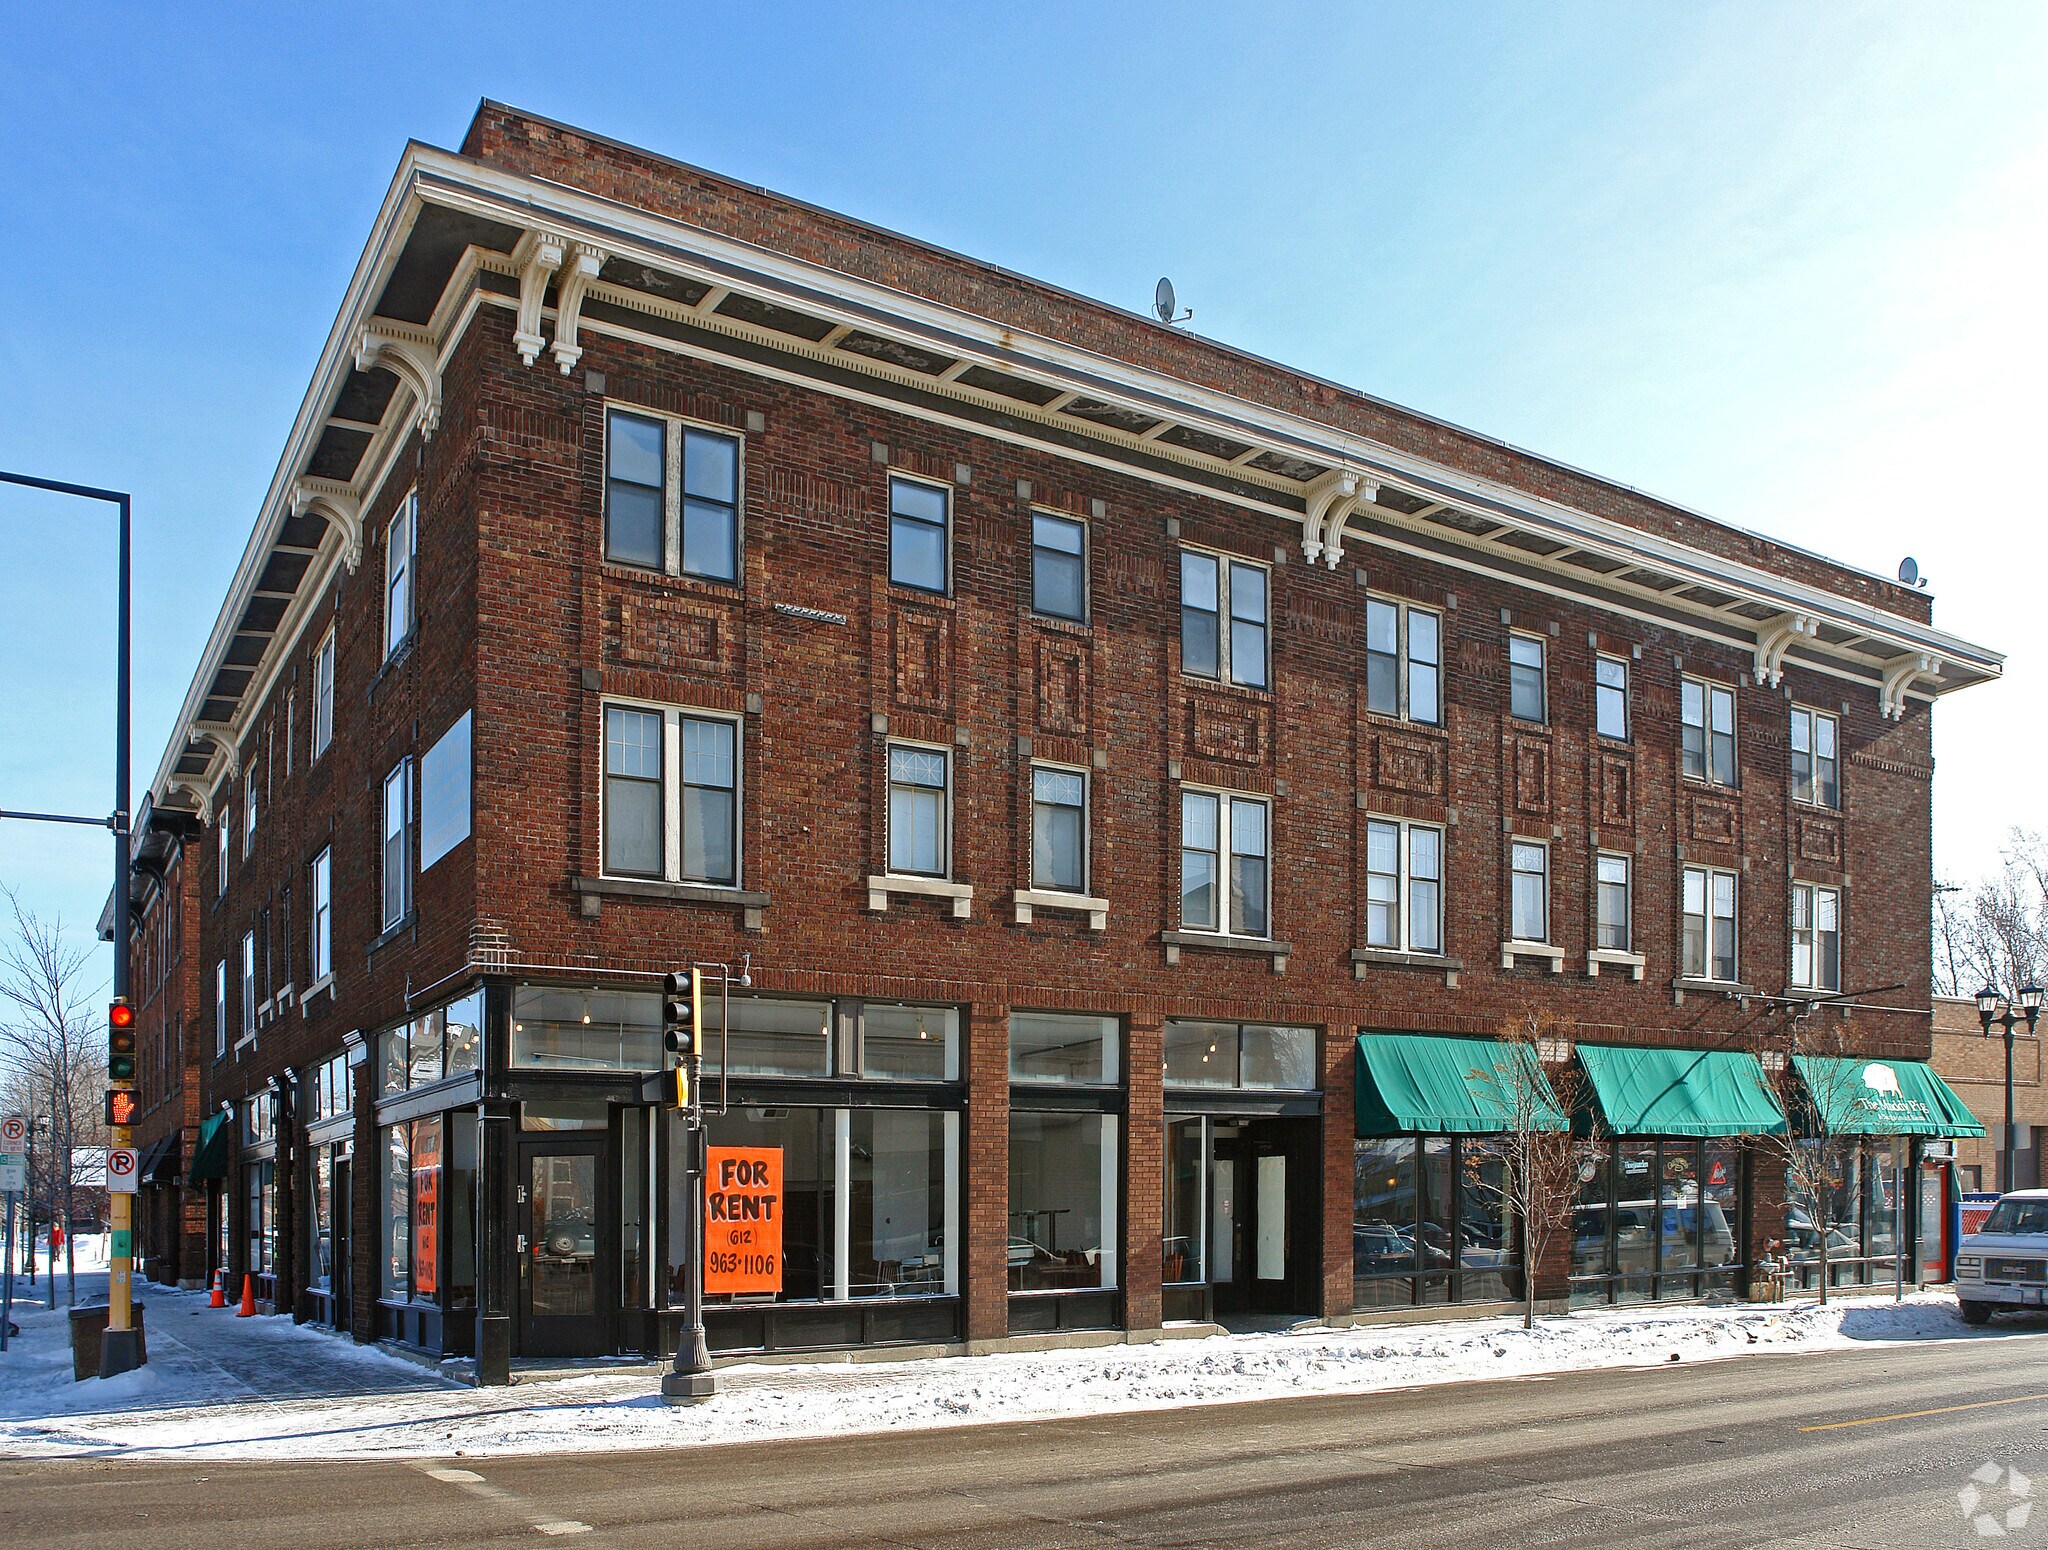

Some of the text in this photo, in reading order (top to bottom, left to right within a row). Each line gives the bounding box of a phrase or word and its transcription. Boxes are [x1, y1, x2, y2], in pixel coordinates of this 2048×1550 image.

[1858, 1097, 1930, 1114] The Muddy Pig
[718, 1158, 769, 1190] FOR
[418, 1202, 435, 1227] RENT
[708, 1192, 777, 1223] RENT
[726, 1228, 758, 1247] (612)
